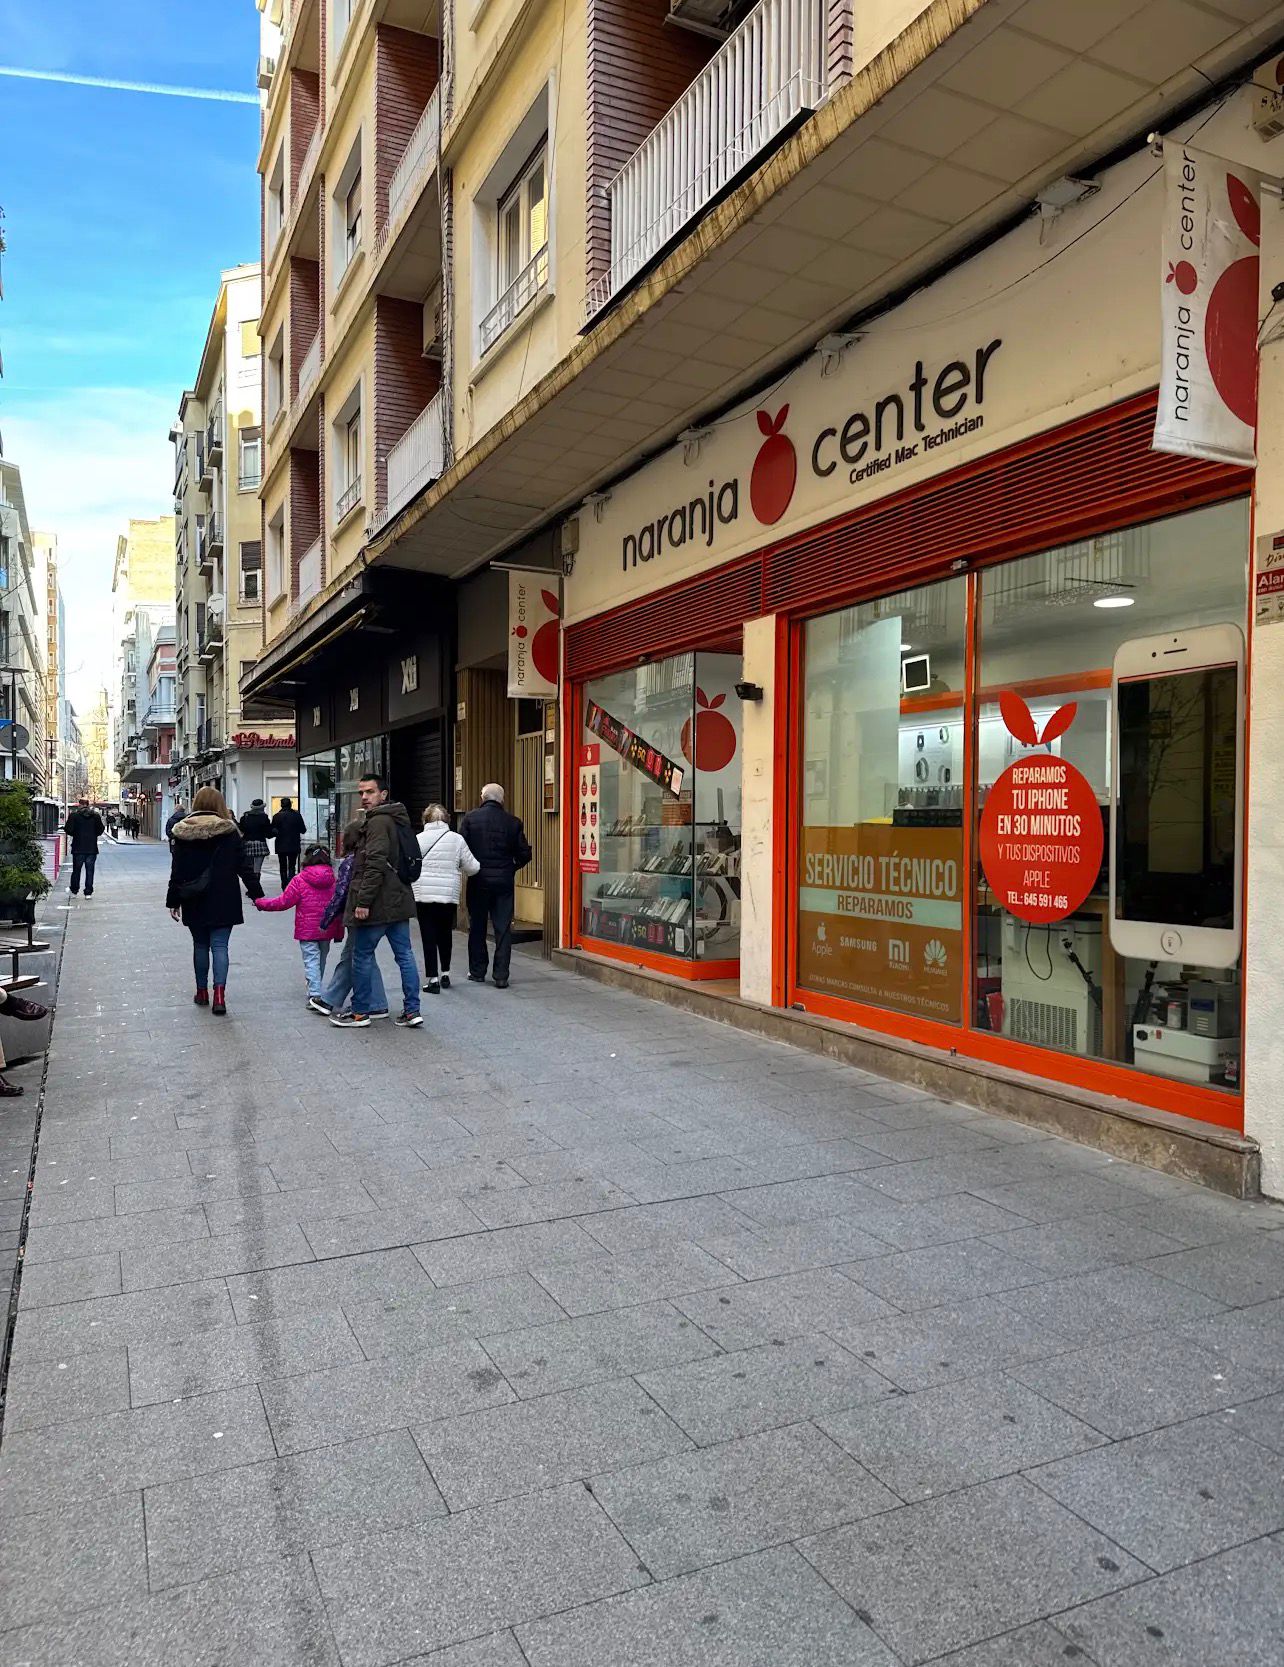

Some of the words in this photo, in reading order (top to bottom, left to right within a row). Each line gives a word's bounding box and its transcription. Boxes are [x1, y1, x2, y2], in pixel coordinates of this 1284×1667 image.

[1179, 150, 1198, 251] center
[1173, 306, 1196, 422] naranja
[622, 478, 739, 572] naranja
[811, 338, 1002, 477] center
[849, 461, 892, 485] Certified
[894, 441, 919, 464] Mac
[922, 414, 984, 452] Technician
[518, 584, 527, 622] center
[517, 642, 528, 686] naranja
[1012, 766, 1067, 785] REPARAMOS
[1012, 789, 1026, 810] TU
[1027, 788, 1069, 810] IPHONE
[997, 815, 1012, 835] EN
[1013, 815, 1029, 835] 30
[1030, 814, 1081, 837] MINUTOS
[997, 843, 1004, 859] Y
[1005, 843, 1022, 861] TUS
[1022, 844, 1080, 863] DISPOSITIVOS
[805, 852, 875, 890] SERVICIO
[879, 850, 957, 897] TÉCNICO
[1023, 870, 1051, 889] APPLE
[837, 894, 914, 920] REPARAMOS
[1024, 892, 1038, 906] 645
[1038, 894, 1053, 908] 591
[1053, 895, 1068, 909] 465
[811, 942, 833, 957] Apple
[840, 935, 878, 952] SAMSUNG
